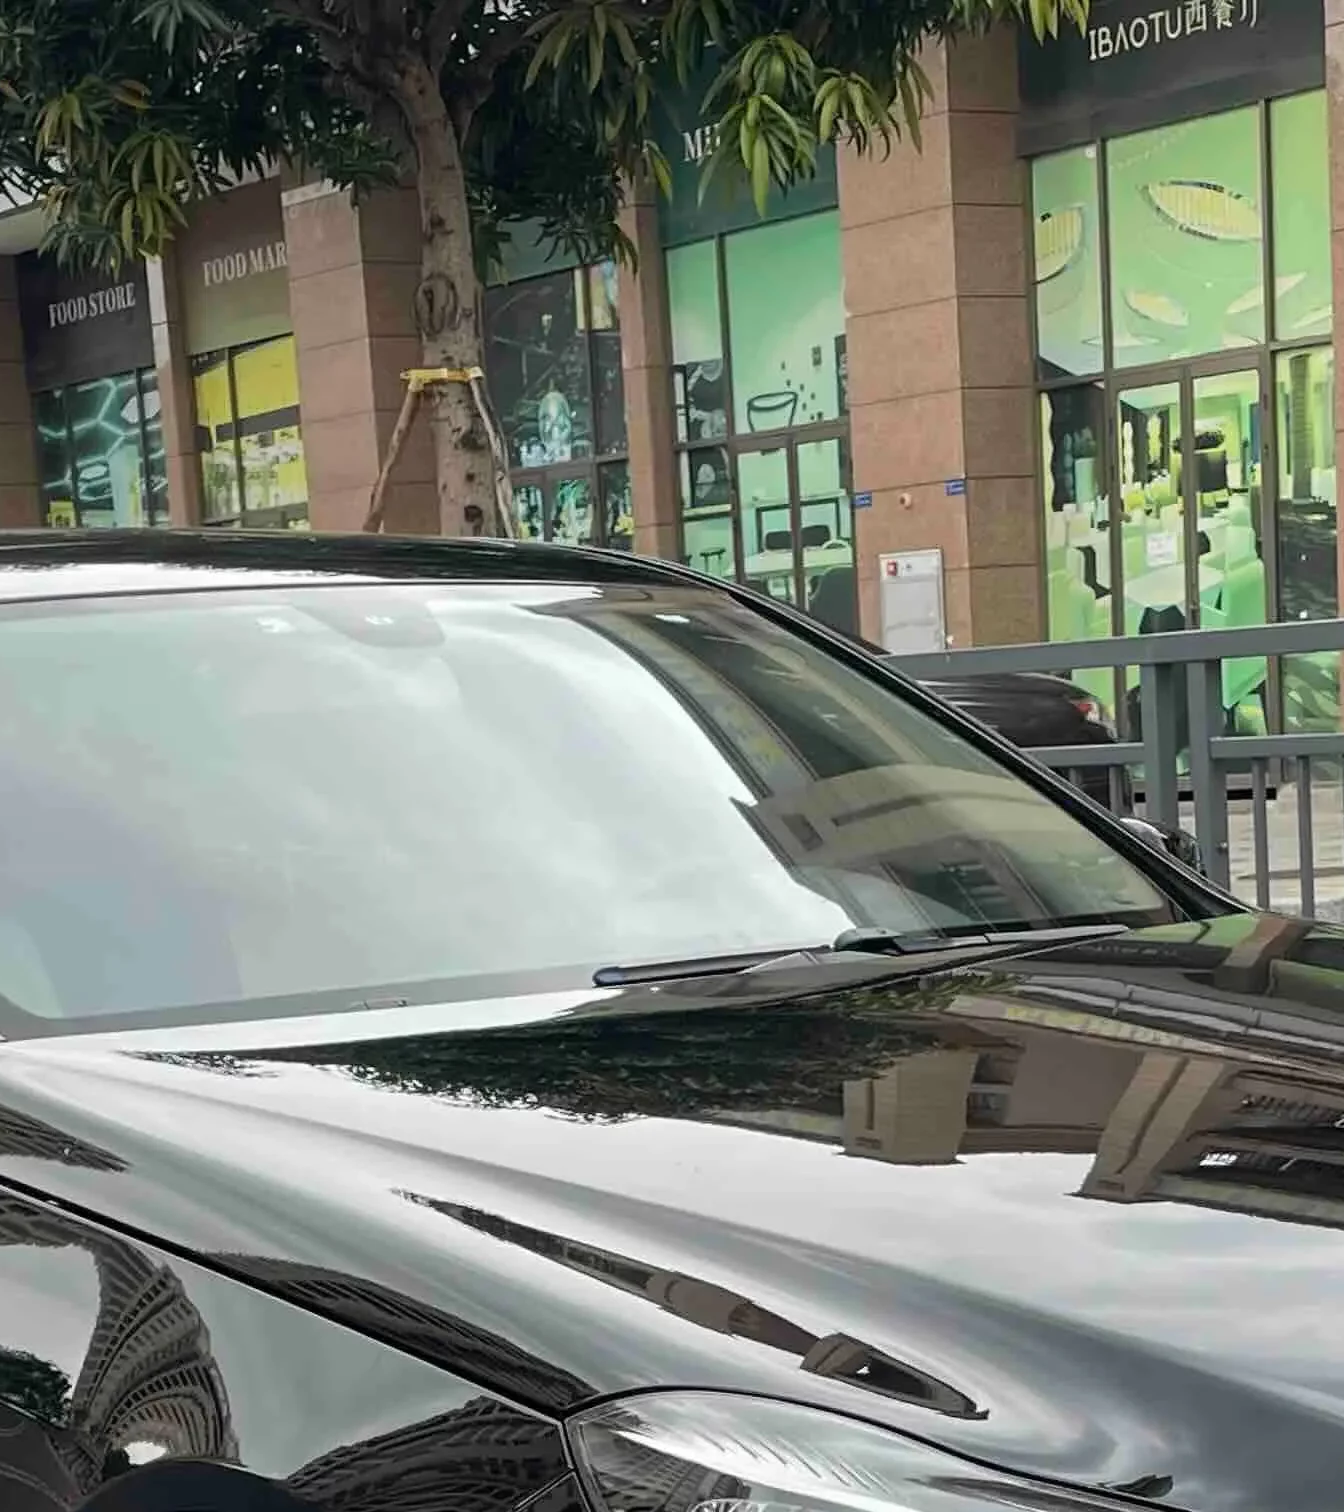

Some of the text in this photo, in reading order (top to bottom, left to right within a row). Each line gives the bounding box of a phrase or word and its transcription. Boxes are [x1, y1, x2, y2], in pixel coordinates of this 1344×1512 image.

[201, 252, 247, 287] FOOD
[48, 282, 136, 329] FOOD STORE
